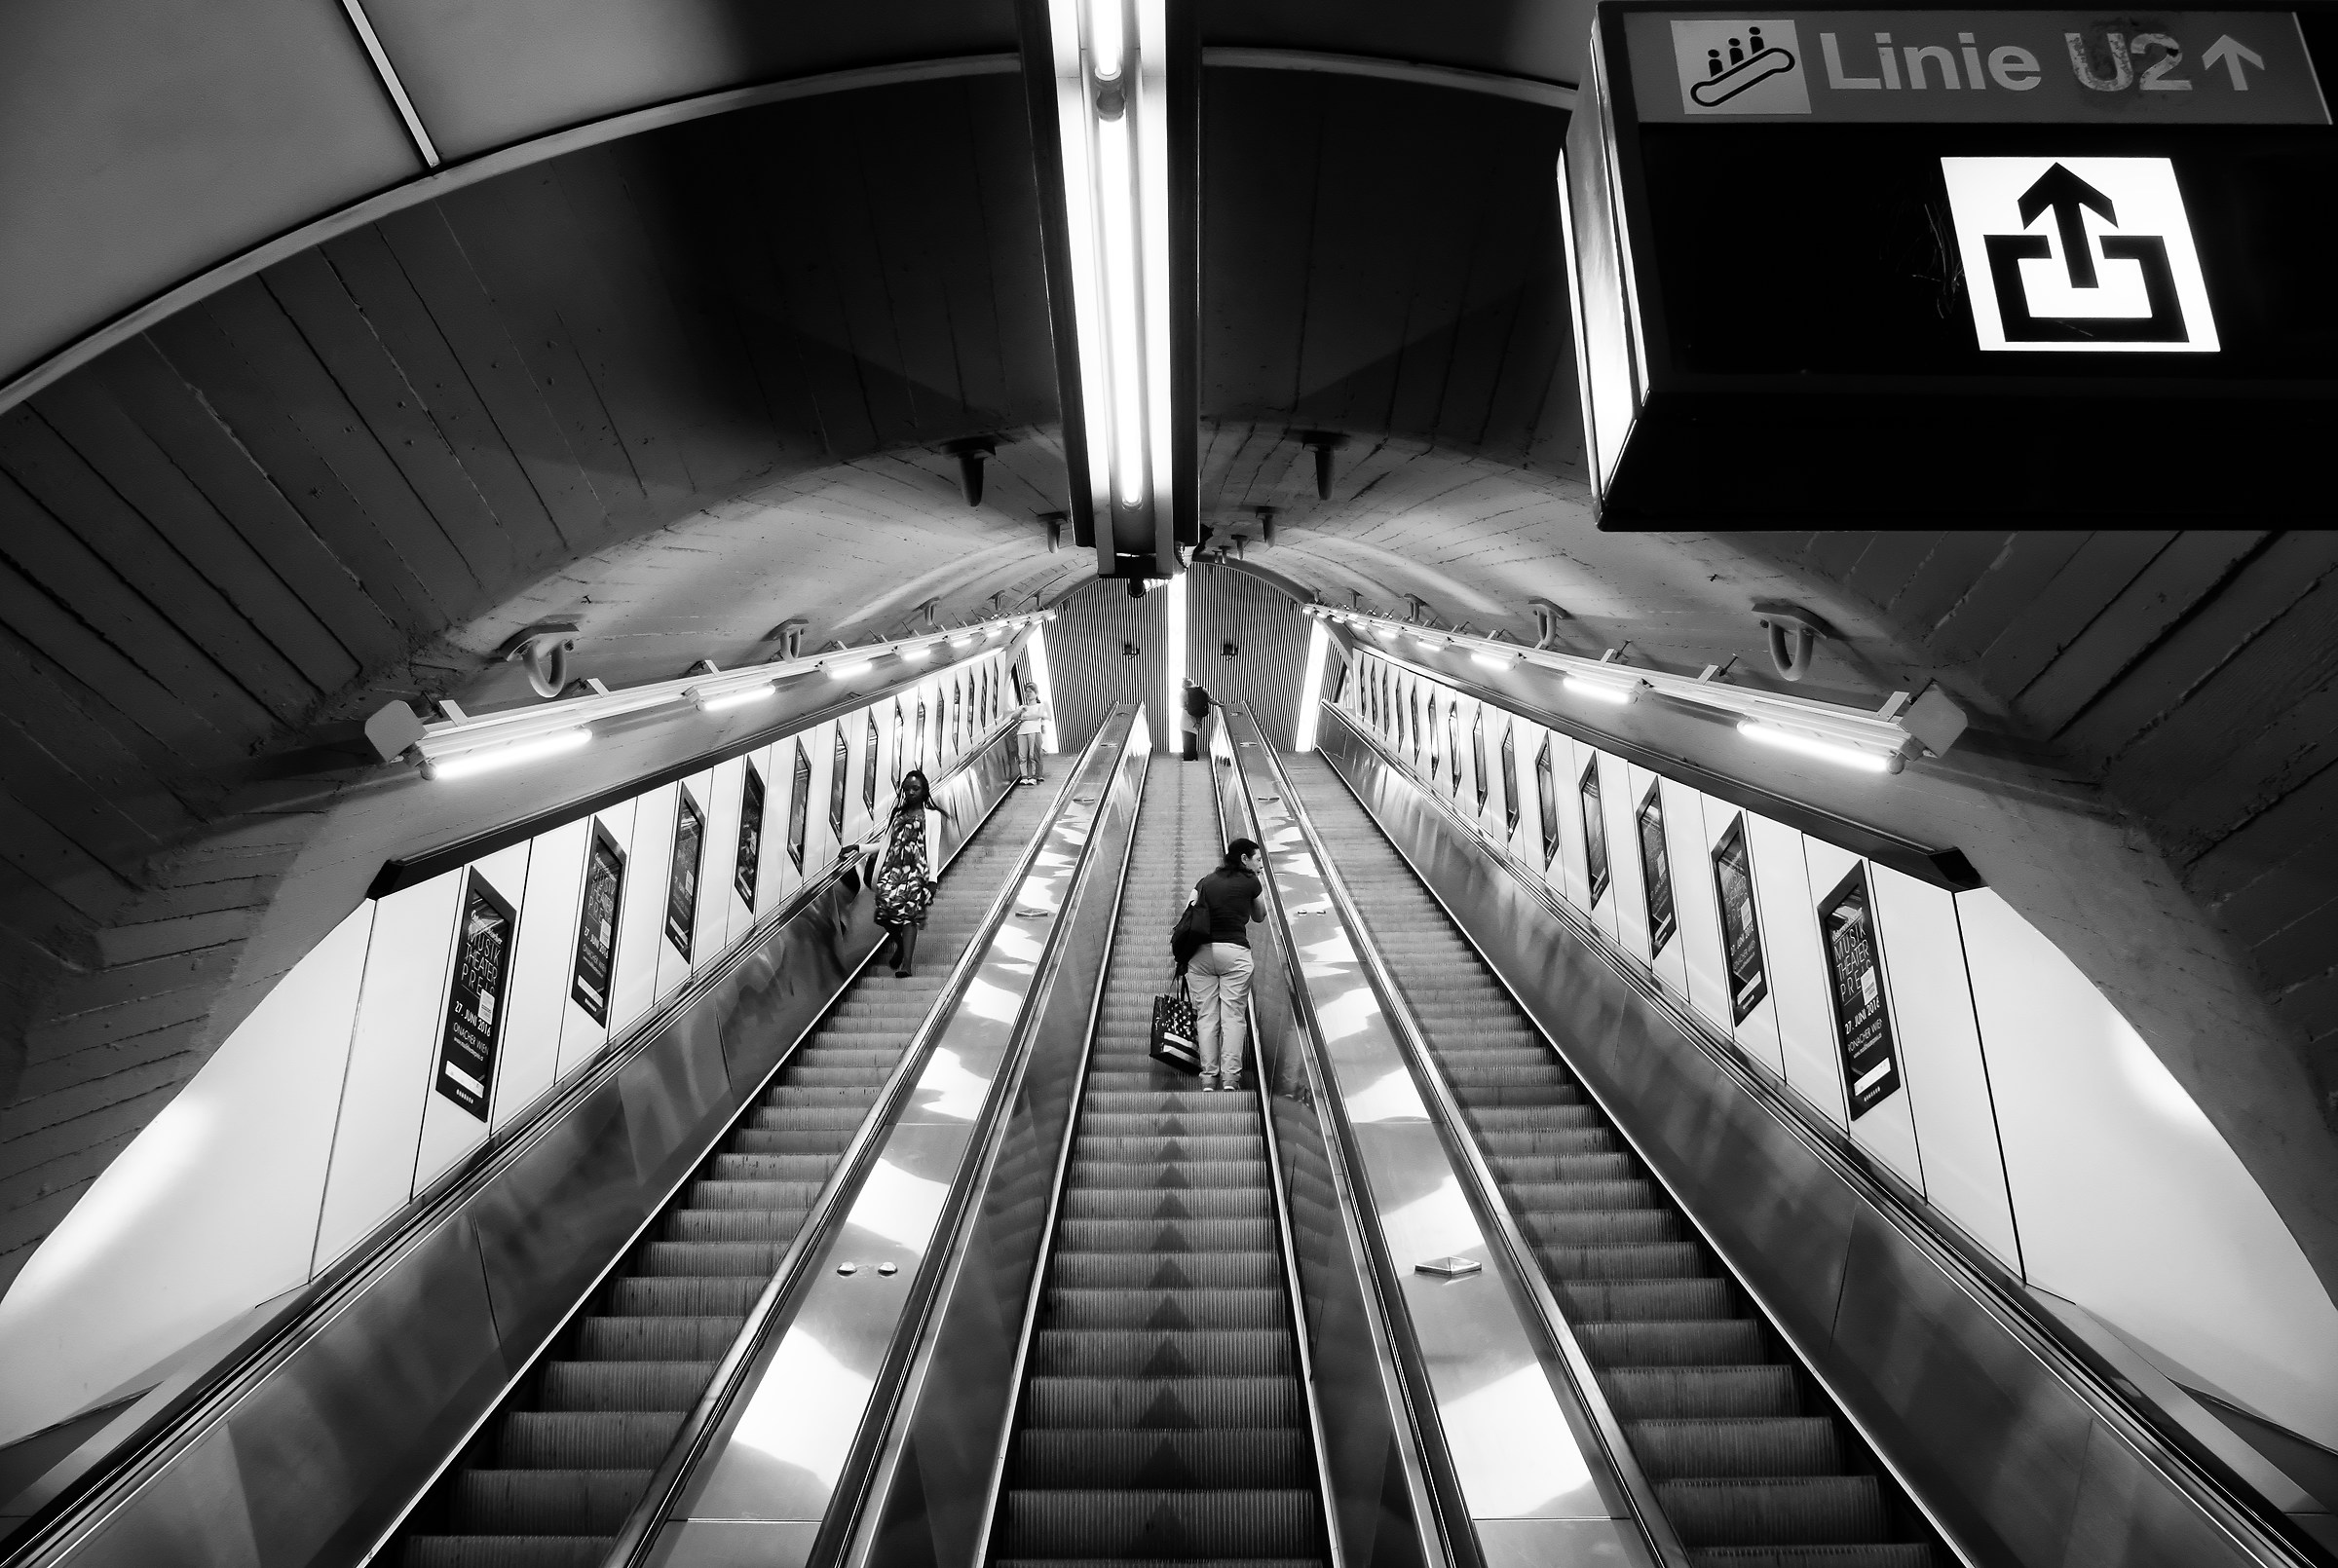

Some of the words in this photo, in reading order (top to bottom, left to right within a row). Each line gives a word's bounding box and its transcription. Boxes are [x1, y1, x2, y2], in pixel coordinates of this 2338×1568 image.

[1819, 32, 2042, 93] Linie
[2064, 32, 2193, 93] U2
[1833, 916, 1866, 963] MUSIK
[1836, 936, 1869, 984] THEATER
[464, 941, 498, 986] THEATER
[454, 999, 464, 1017] 27.
[477, 1018, 491, 1038] 2016
